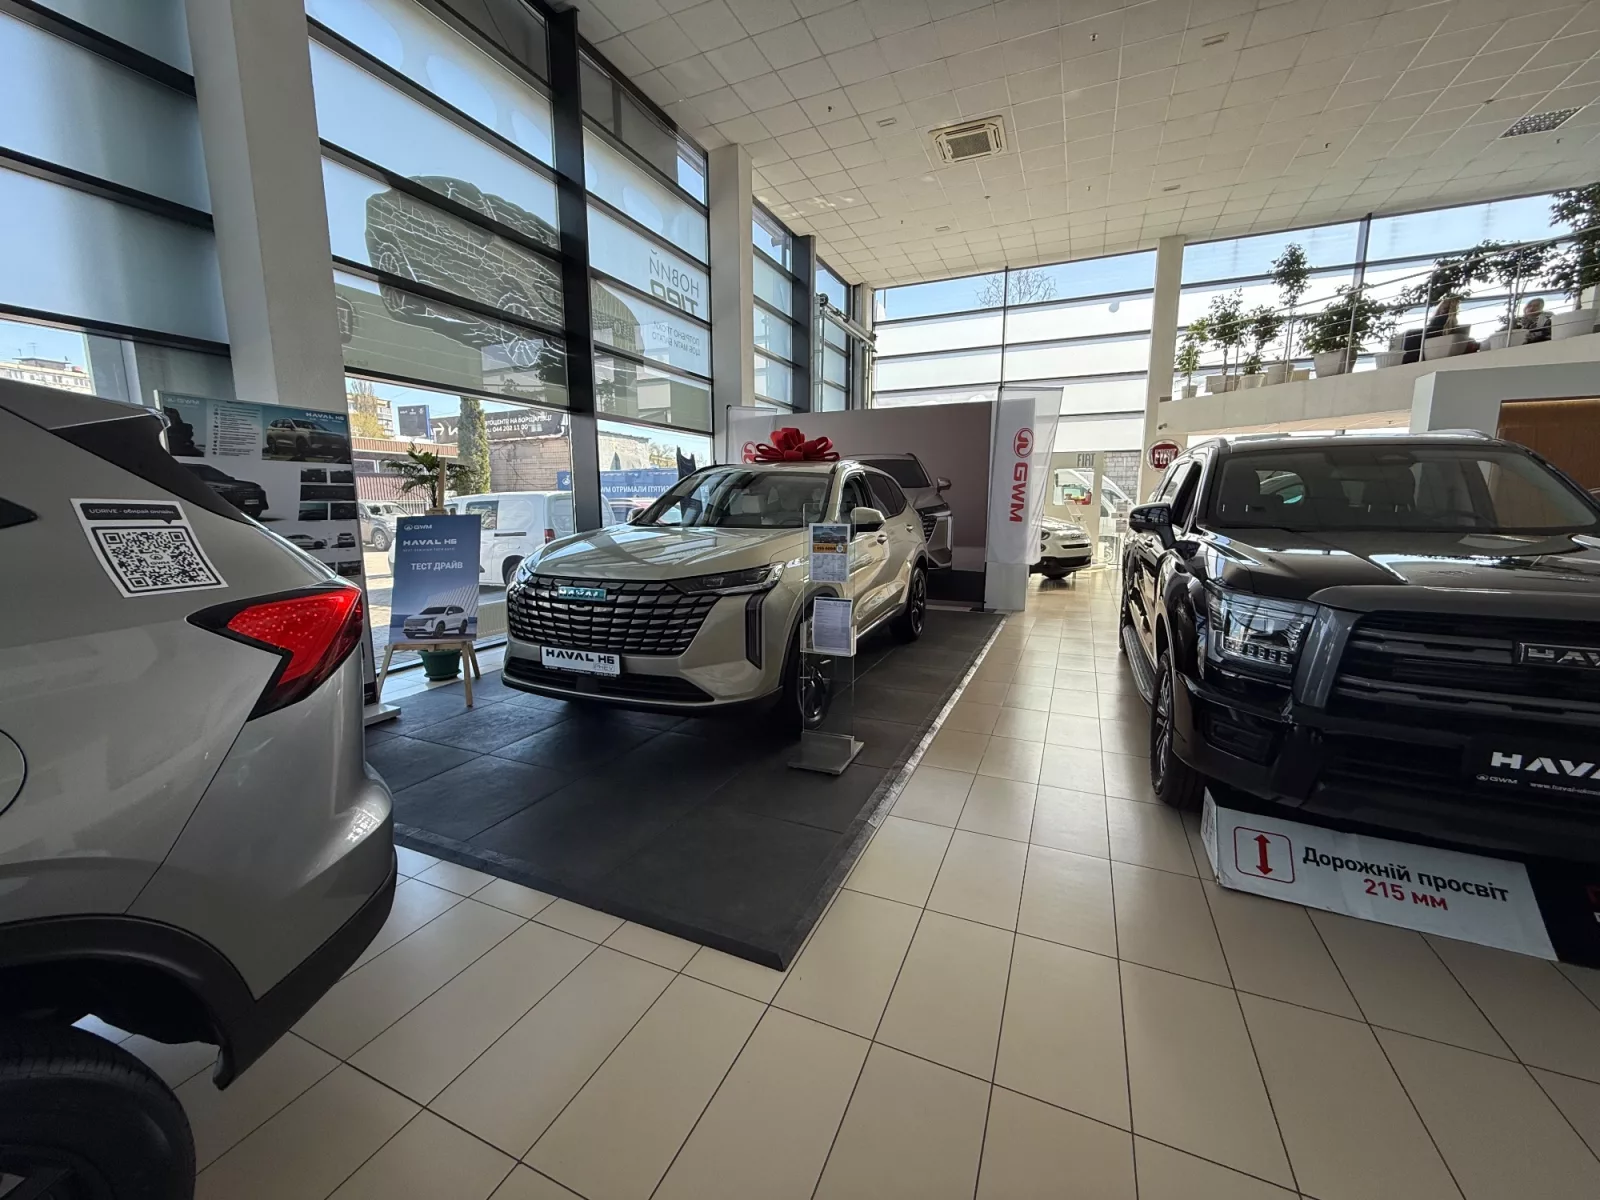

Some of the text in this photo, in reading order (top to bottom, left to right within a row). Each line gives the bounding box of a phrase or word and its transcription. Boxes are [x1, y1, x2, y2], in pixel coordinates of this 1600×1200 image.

[305, 412, 334, 420] HAVAL
[1077, 453, 1096, 468] FIAT
[611, 485, 647, 493] ОТРИМАЛИ
[1008, 461, 1029, 523] GWM
[411, 560, 463, 571] ТЕСТ ДРАЙВ
[545, 648, 615, 665] HAVAL H6
[1489, 775, 1518, 785] GWM
[1302, 846, 1509, 902] Дорожній просвіт
[1363, 878, 1449, 911] 215 мм
